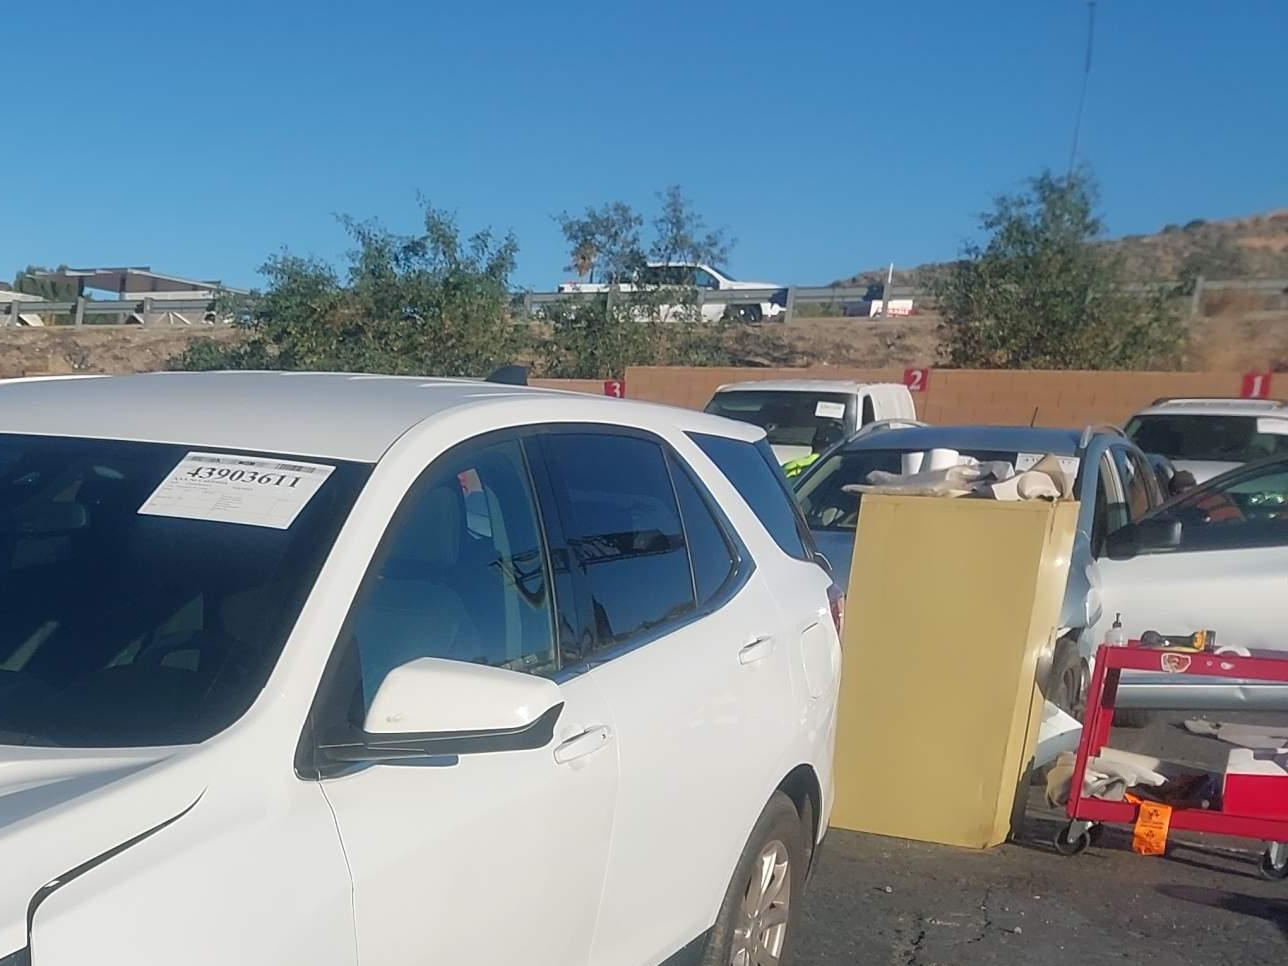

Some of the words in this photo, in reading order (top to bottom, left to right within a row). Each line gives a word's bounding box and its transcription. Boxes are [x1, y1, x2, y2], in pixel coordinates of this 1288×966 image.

[909, 370, 922, 390] 2
[1250, 375, 1264, 399] 1
[187, 466, 301, 488] 43903611
